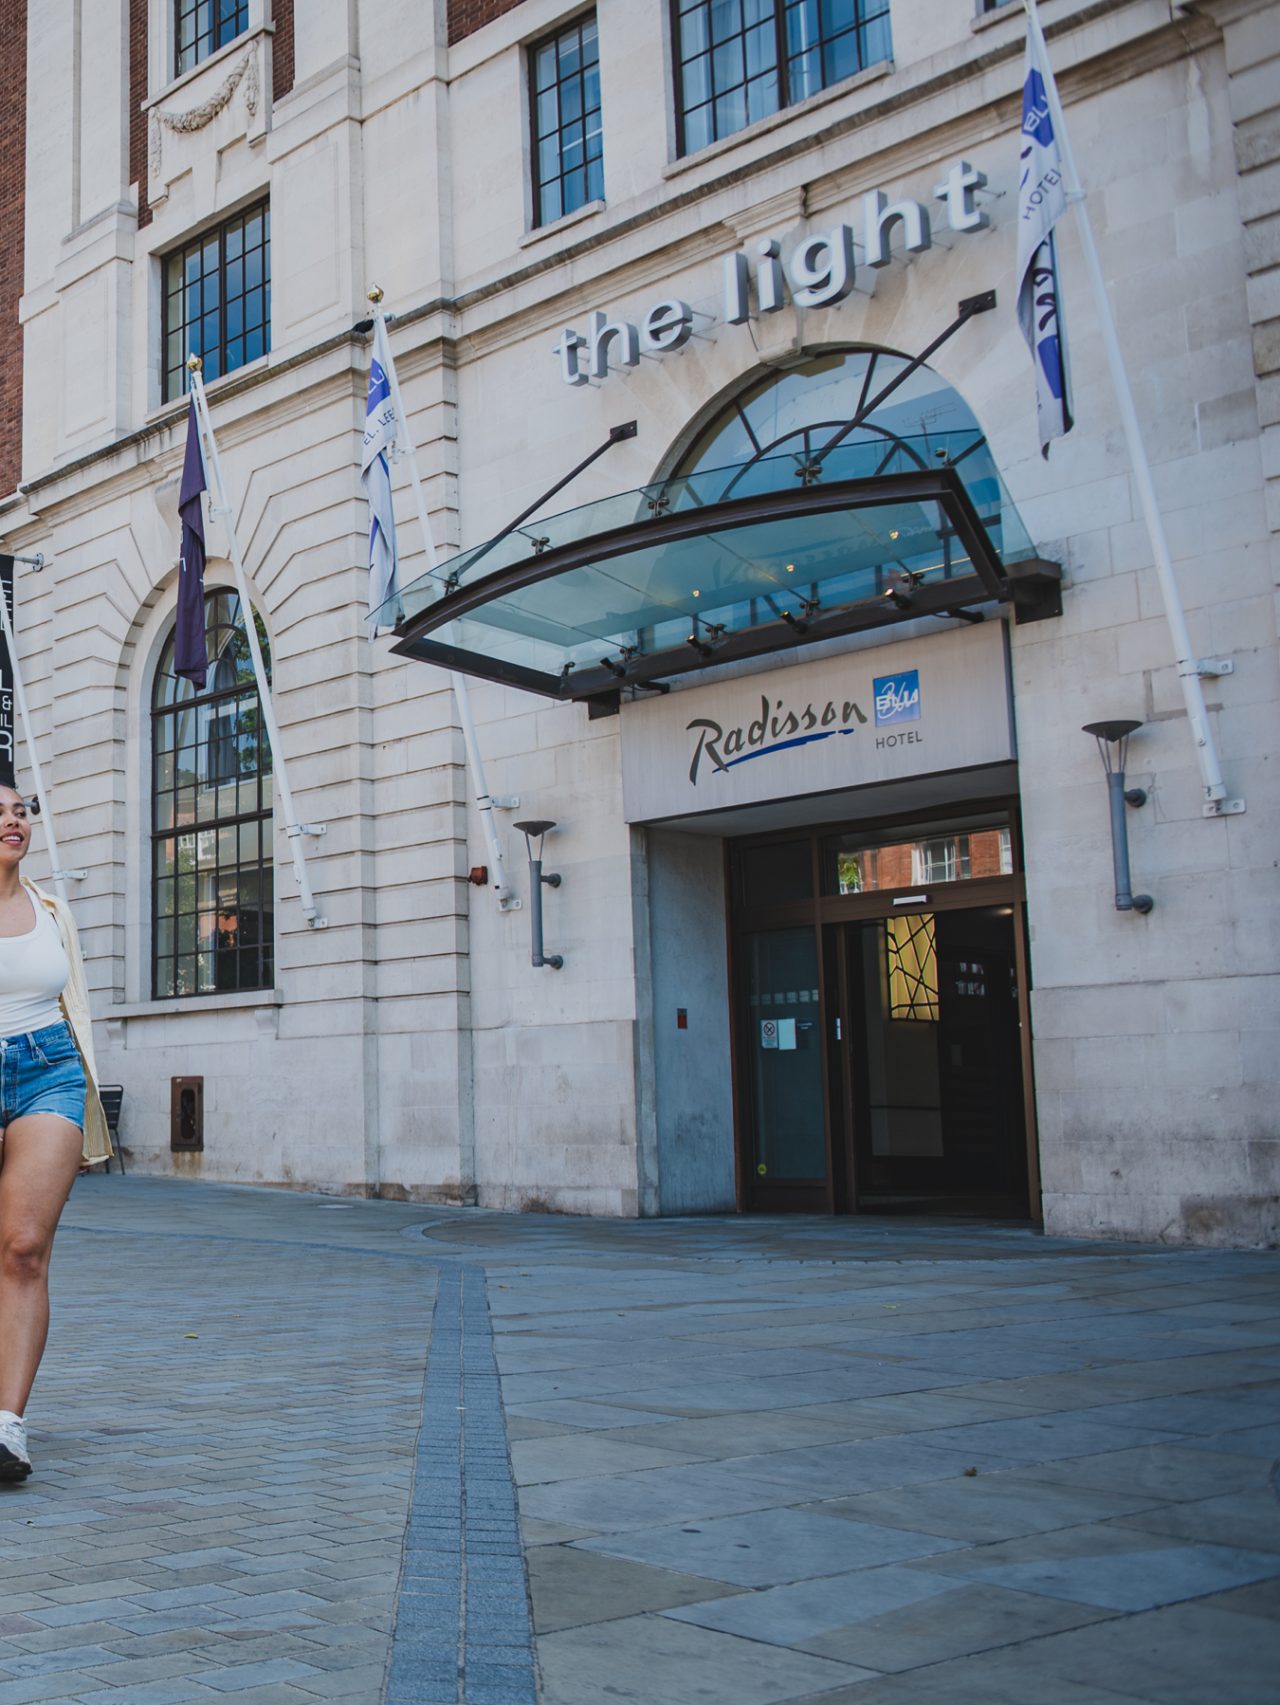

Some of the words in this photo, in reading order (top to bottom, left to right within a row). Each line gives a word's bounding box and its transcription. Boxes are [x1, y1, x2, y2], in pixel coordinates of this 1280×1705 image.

[552, 300, 693, 387] the
[724, 160, 990, 325] light
[378, 407, 396, 427] LEE
[2, 695, 13, 711] &
[686, 694, 868, 786] Radisson
[876, 732, 923, 749] HOTEL
